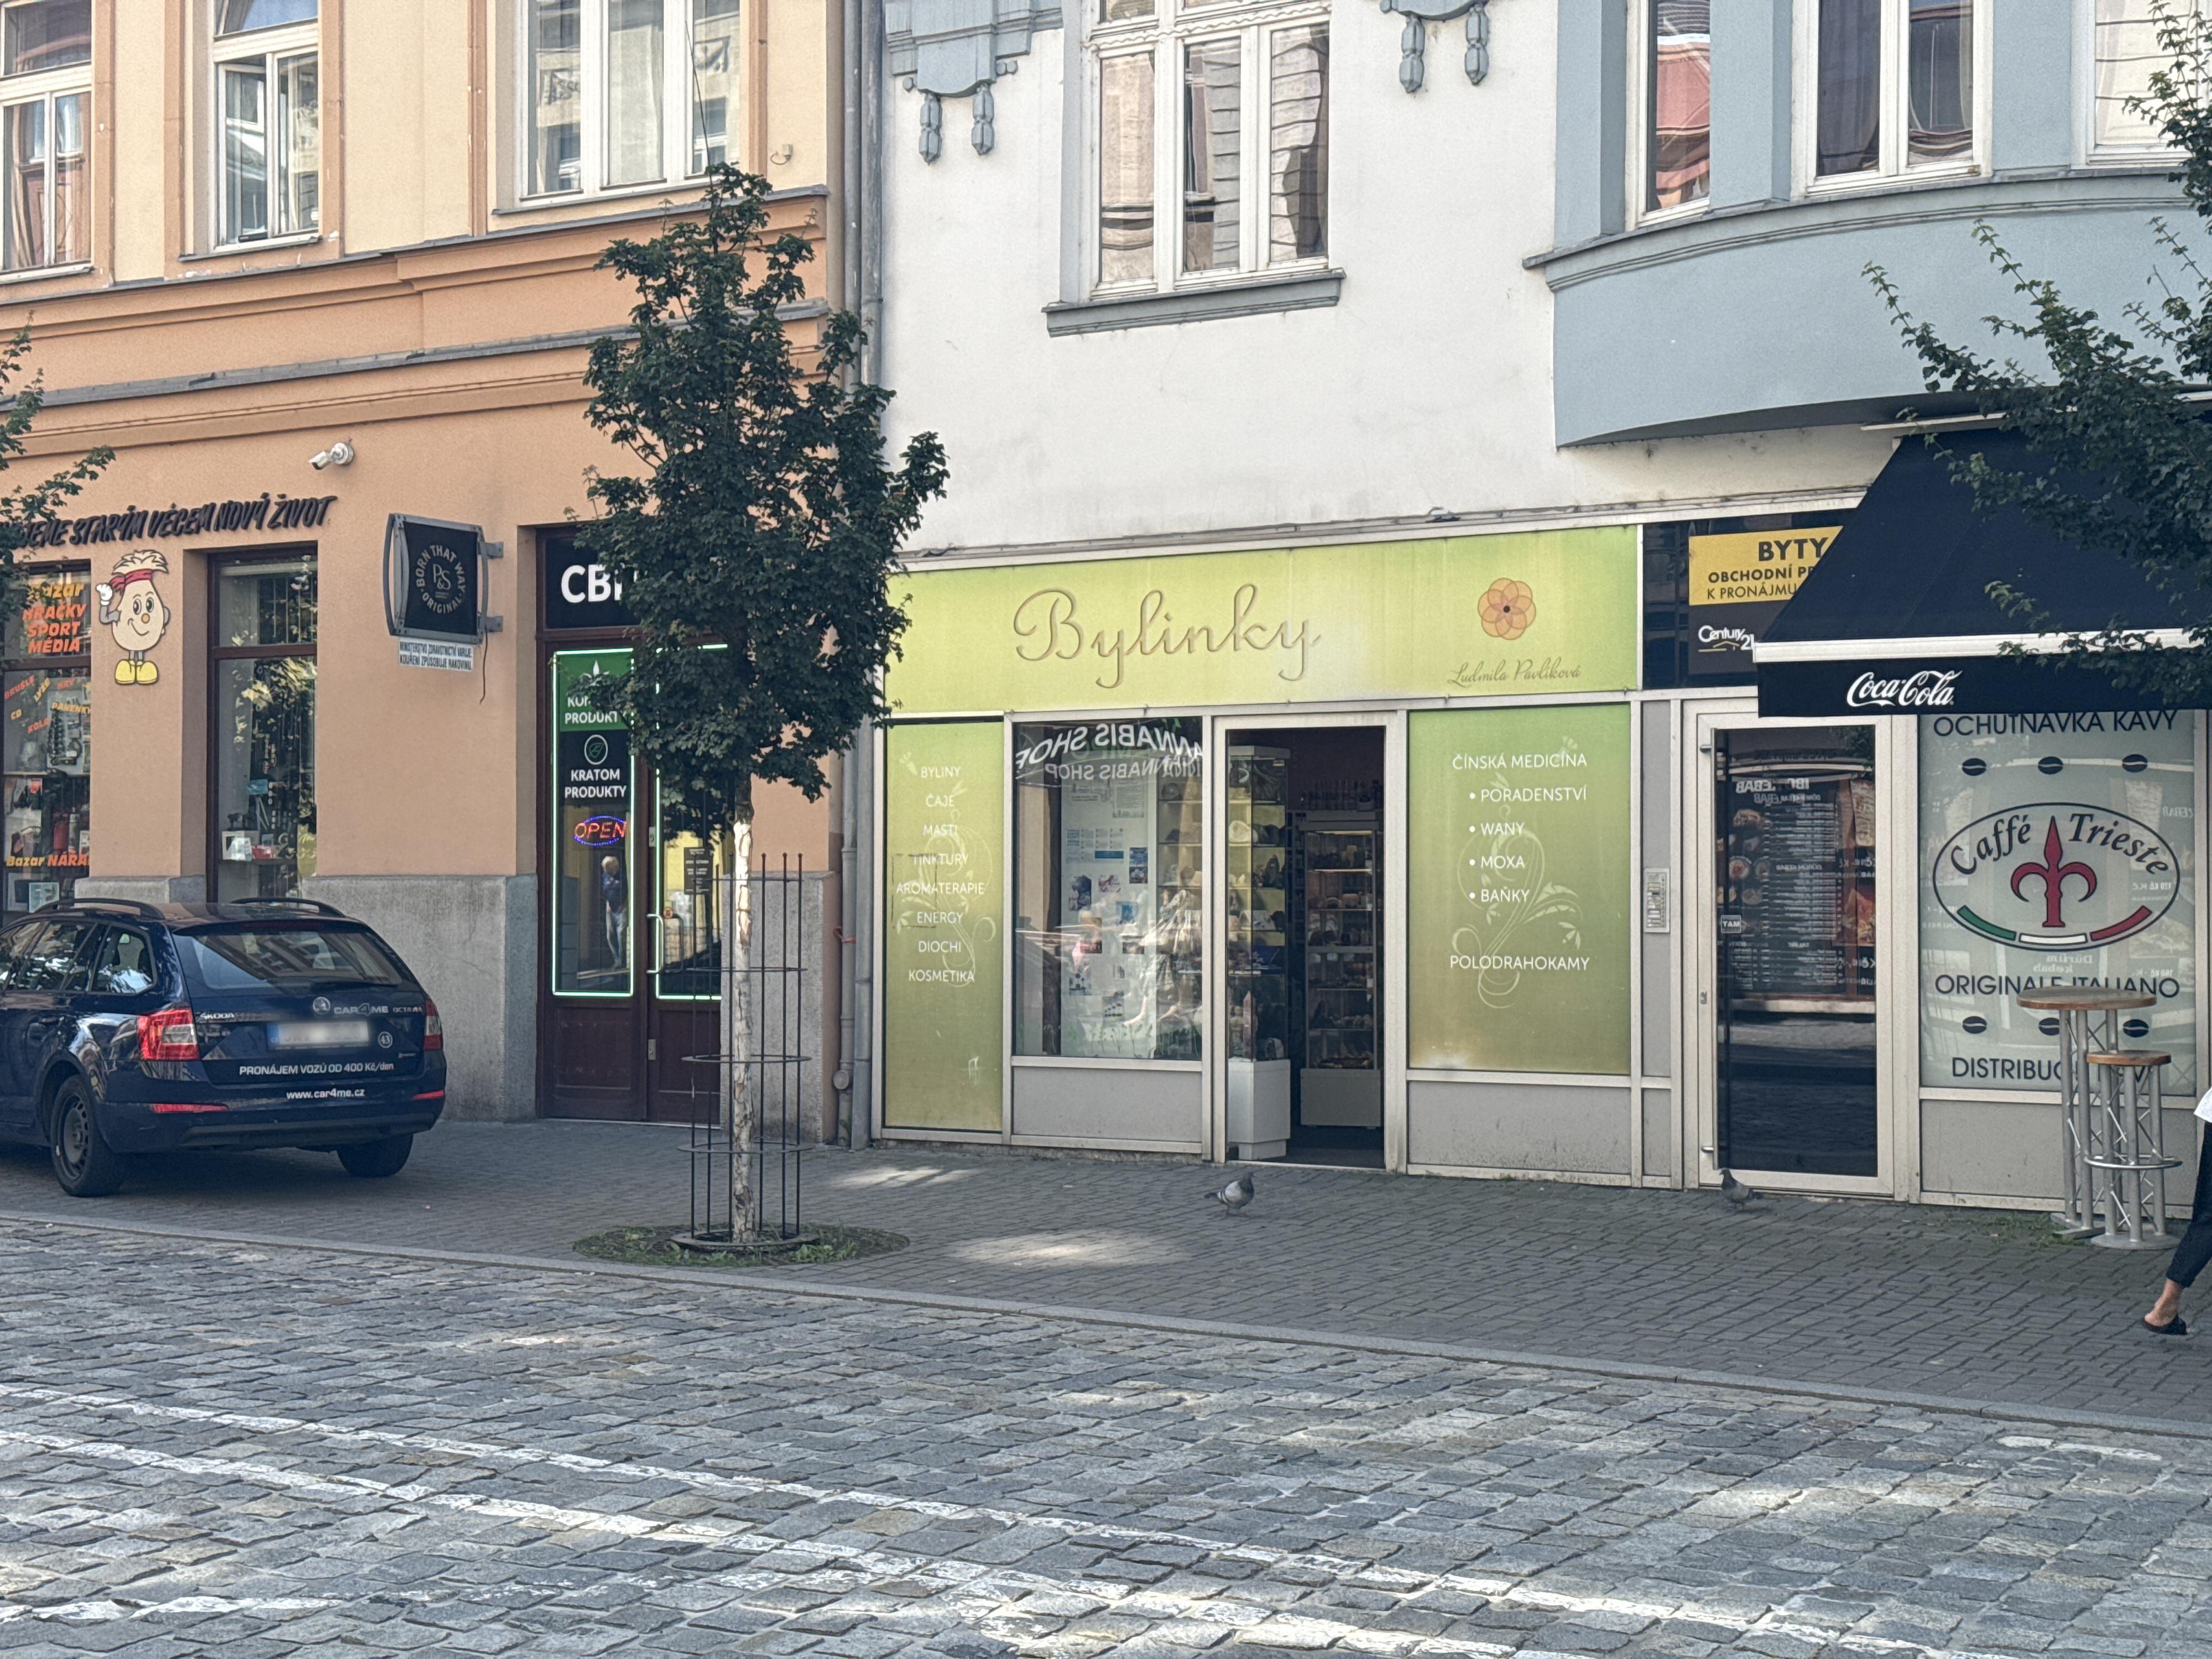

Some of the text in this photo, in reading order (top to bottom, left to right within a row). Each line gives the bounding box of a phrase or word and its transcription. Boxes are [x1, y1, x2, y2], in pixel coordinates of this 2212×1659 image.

[69, 504, 148, 545] STARÝM
[213, 492, 270, 531] NOVÝ
[267, 493, 338, 529] ŽIVOT
[1759, 536, 1828, 562] BYTY
[415, 544, 467, 594] BORN THAT WAY
[1708, 564, 1792, 584] OBCHODNÍ
[1707, 587, 1715, 600] K
[27, 621, 81, 638] SPORT
[1014, 583, 1321, 688] Bylinky
[1698, 625, 1746, 643] Century
[1447, 659, 1507, 688] Ludmila
[1846, 670, 1963, 707] Coca-Cola
[1452, 753, 1507, 770] ČÍNSKÁ
[571, 768, 620, 782] KRATOM
[920, 765, 961, 779] BYLINY
[565, 785, 627, 799] PRODUKTY
[926, 792, 956, 807] ČAJE
[1480, 784, 1587, 802] PORADENSTVÍ
[574, 821, 627, 839] OPEN
[923, 825, 958, 837] MASTI
[1480, 822, 1525, 836] WANY
[1950, 813, 2169, 875] Caffé Trieste
[6, 855, 45, 867] Bazar
[914, 852, 969, 865] TINKTURY
[1481, 855, 1525, 869] MOXA
[896, 882, 985, 895] AROMATERAPIE
[1481, 886, 1530, 902] BAŇKY
[916, 911, 963, 924] ENERGY
[919, 941, 962, 953] DIOCHI
[1449, 956, 1590, 971] POLODRAHOKAMY
[909, 969, 975, 983] KOSMETIKA
[239, 1063, 298, 1076] PRONÁJEM
[328, 1064, 342, 1073] OD
[343, 1062, 363, 1072] 400
[364, 1061, 394, 1072] Kč/den
[286, 1087, 366, 1100] www.car4me.cz
